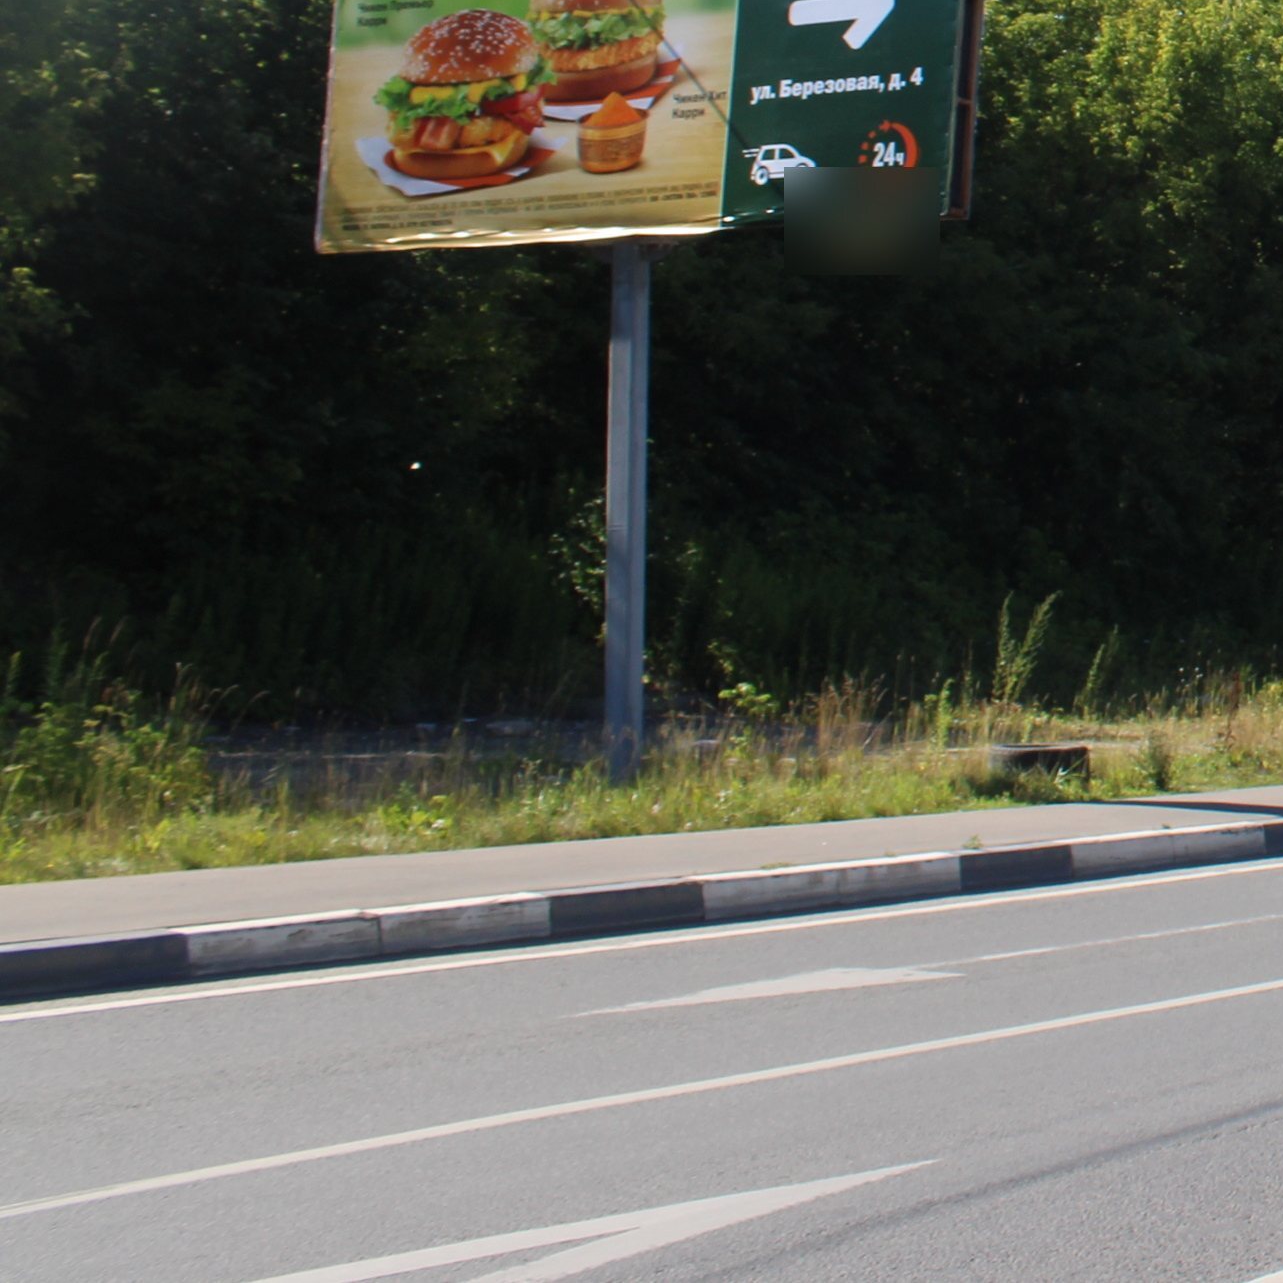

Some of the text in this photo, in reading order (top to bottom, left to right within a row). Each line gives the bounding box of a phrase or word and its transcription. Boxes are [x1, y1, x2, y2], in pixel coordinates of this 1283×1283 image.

[750, 67, 924, 105] ул. Березовая, д. 4
[872, 141, 905, 167] 24ч
